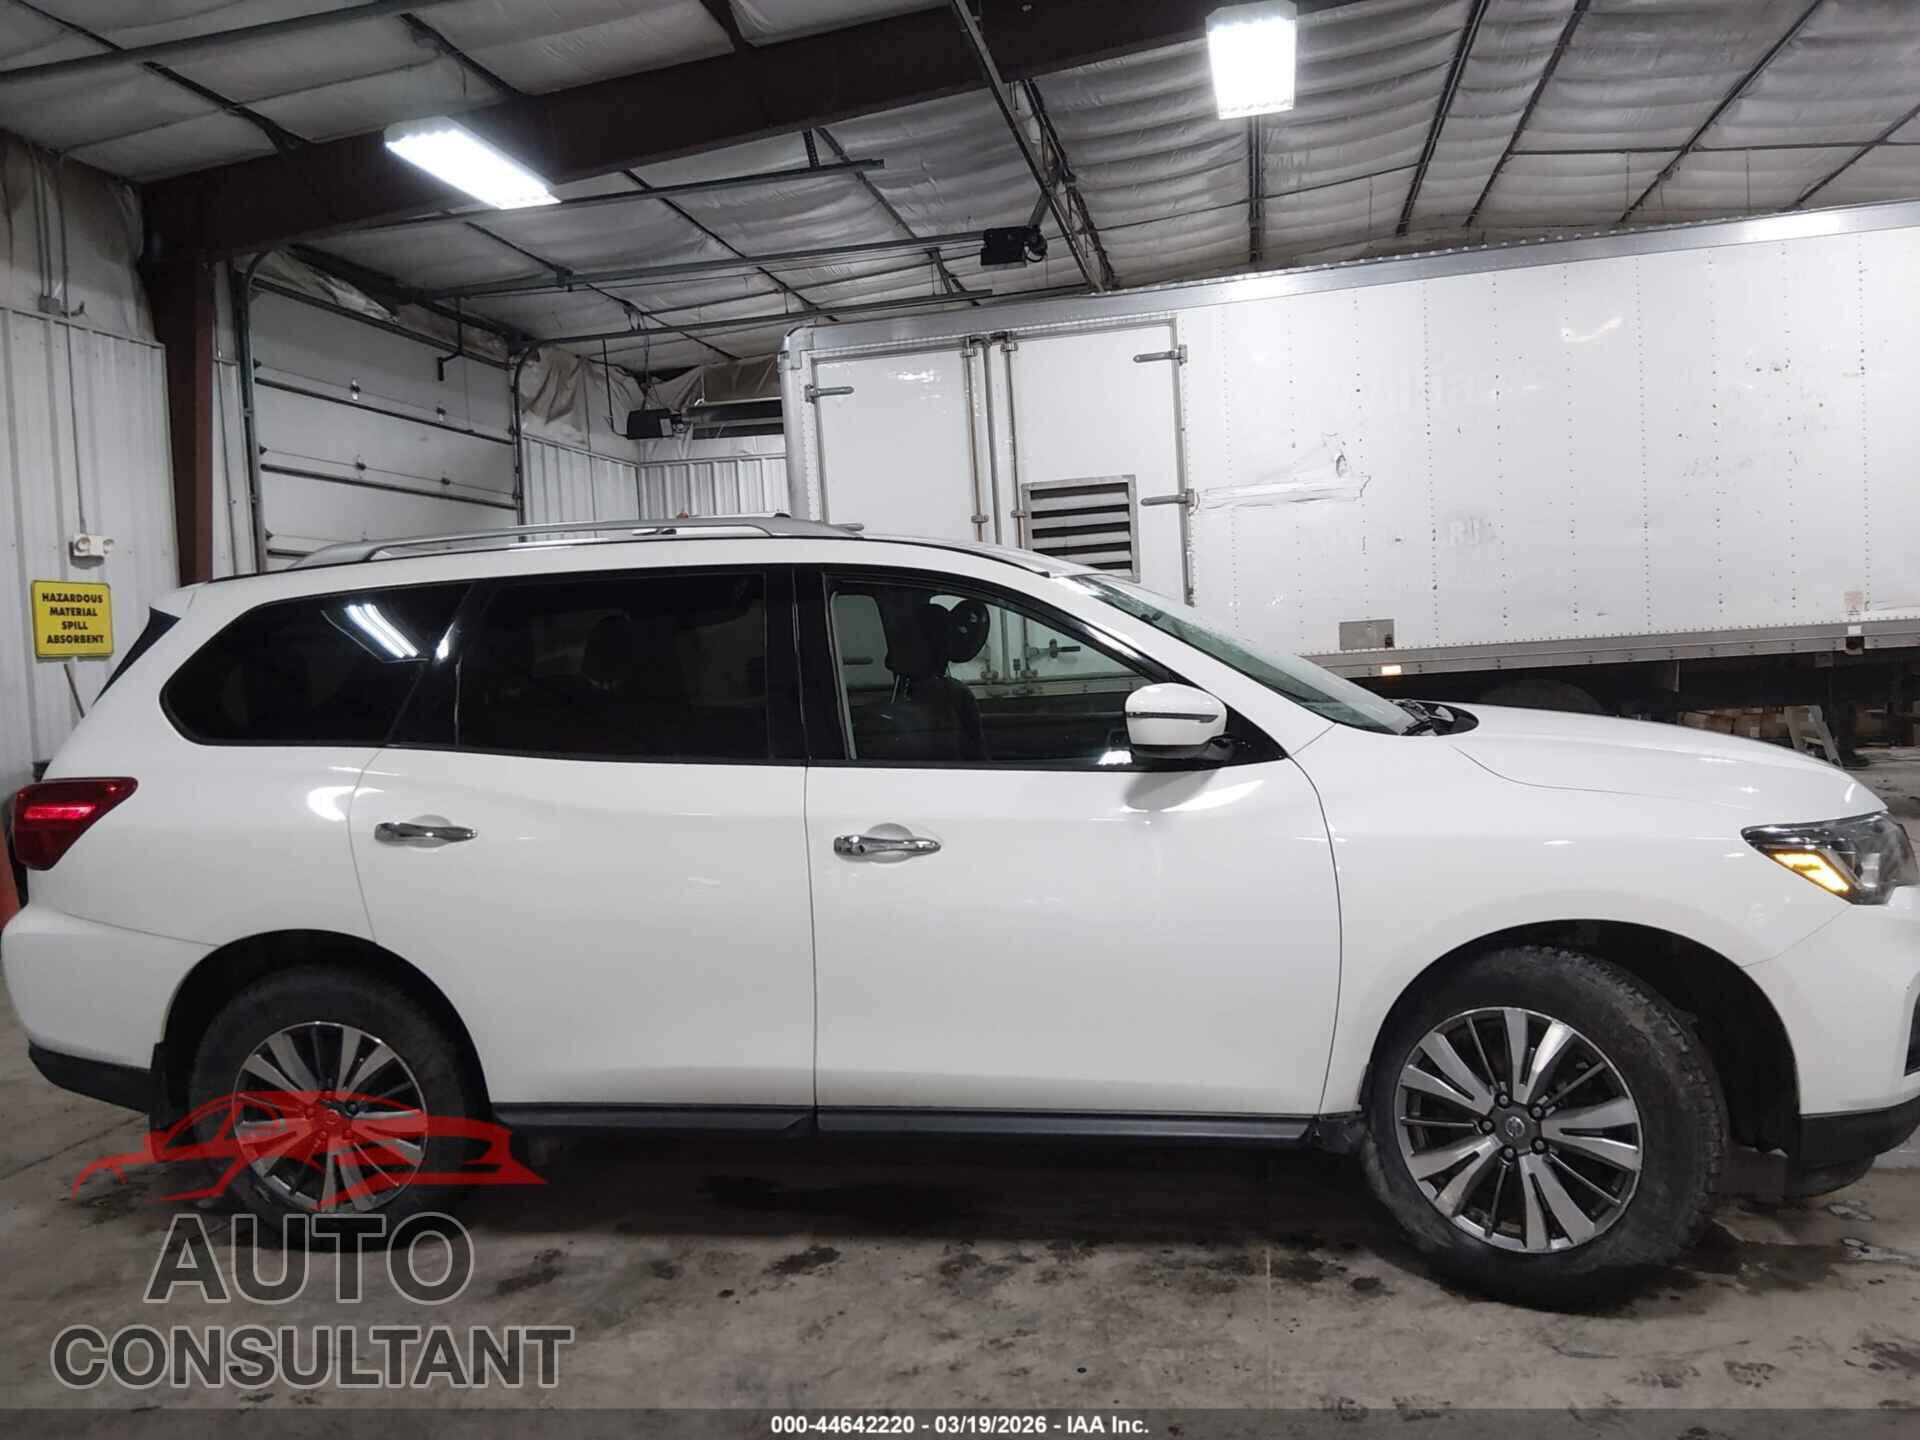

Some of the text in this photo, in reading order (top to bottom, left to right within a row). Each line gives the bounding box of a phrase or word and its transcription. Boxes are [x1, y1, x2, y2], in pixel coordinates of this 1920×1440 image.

[41, 592, 104, 604] HAZARDOUS
[49, 606, 98, 617] MATERIAL
[61, 620, 89, 631] SPILL
[46, 634, 105, 645] ABSORBENT
